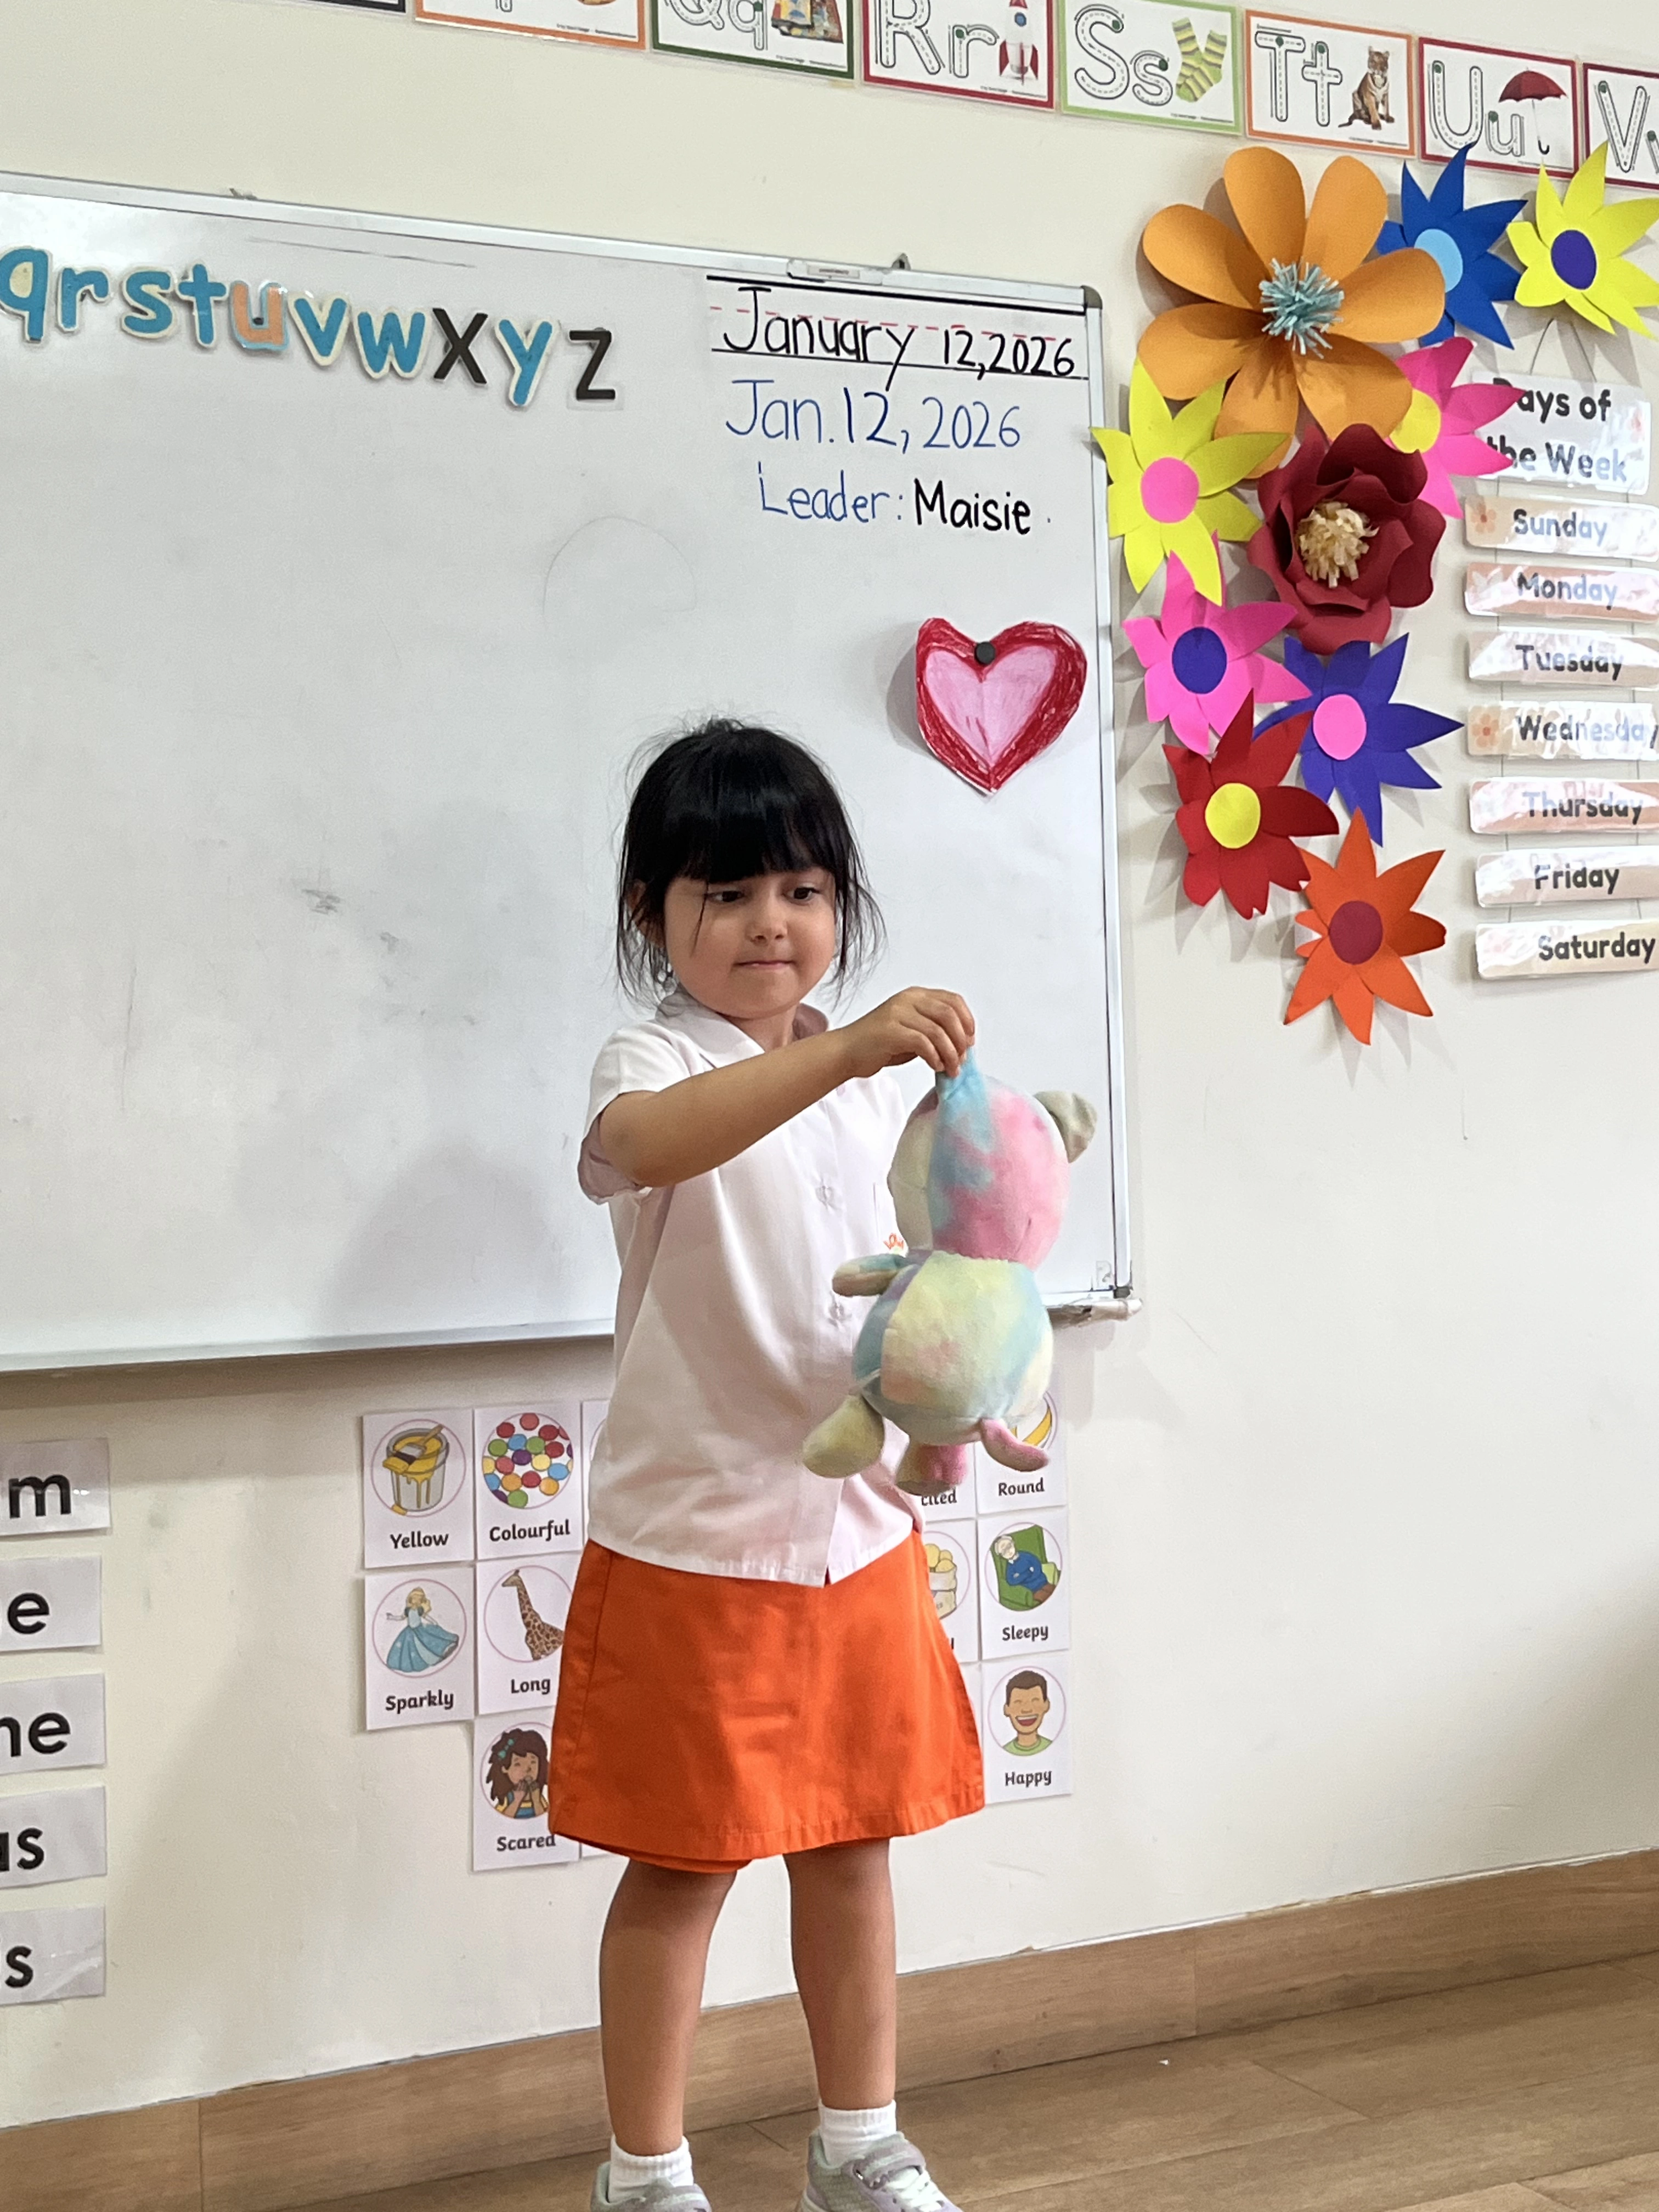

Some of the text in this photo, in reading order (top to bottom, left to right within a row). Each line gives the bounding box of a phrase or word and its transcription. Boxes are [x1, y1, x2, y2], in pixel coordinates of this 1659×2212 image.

[1074, 4, 1173, 106] Ss
[1255, 31, 1342, 127] Tt
[1427, 60, 1524, 157] Uu
[1594, 80, 1659, 173] V
[723, 287, 915, 391] January
[1493, 377, 1611, 424] ays of
[1545, 441, 1627, 482] Week
[759, 461, 1031, 534] Leader: Maisie
[1513, 508, 1608, 548] Sunday
[1517, 572, 1618, 611] Monday
[1515, 644, 1624, 681] Tuesday
[1522, 792, 1644, 826] Thursday
[1534, 864, 1620, 895] Friday
[1538, 931, 1656, 964] Saturday
[998, 1477, 1045, 1497] Round
[390, 1531, 449, 1549] Yellow
[489, 1519, 571, 1542] Colourful
[1001, 1624, 1049, 1642] Sleepy
[385, 1689, 455, 1714] Sparkly
[511, 1678, 550, 1695] Long
[1005, 1769, 1052, 1787] Happy
[496, 1834, 556, 1852] Scared
